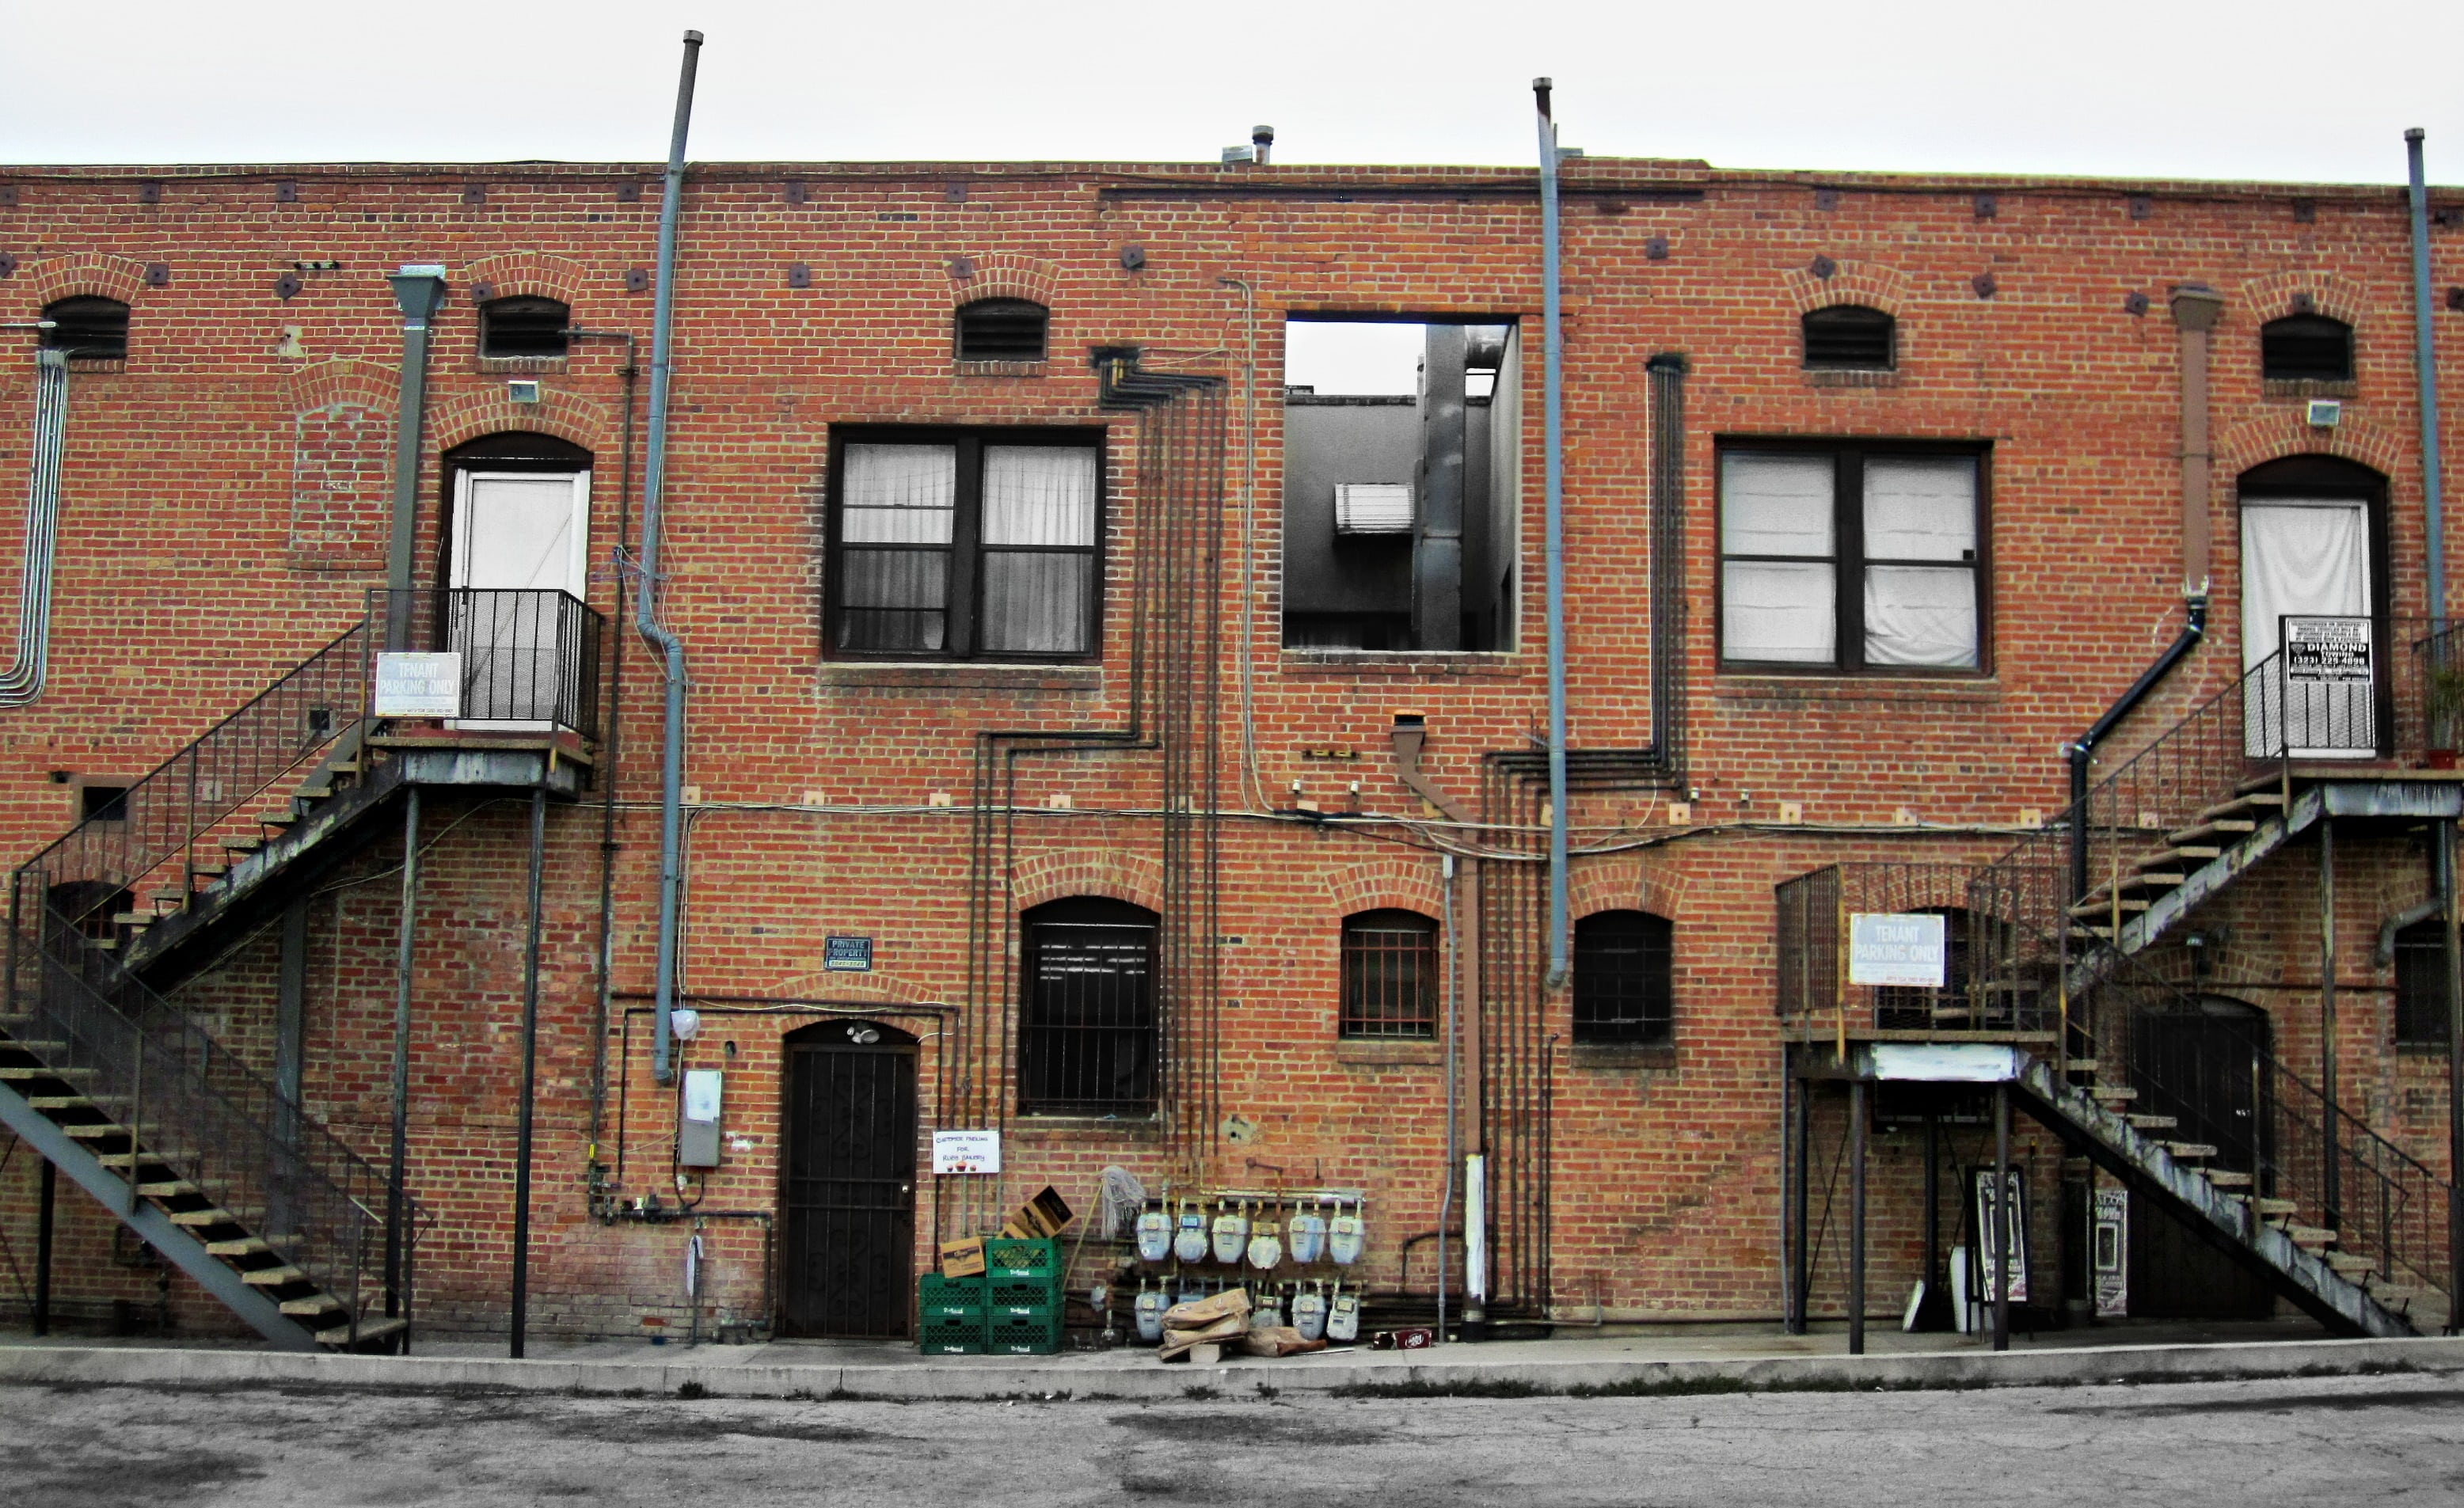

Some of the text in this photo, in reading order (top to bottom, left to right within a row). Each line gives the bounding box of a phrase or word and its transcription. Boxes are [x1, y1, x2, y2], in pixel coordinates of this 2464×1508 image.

[2307, 643, 2367, 652] DIAMOND
[398, 662, 439, 678] TENANT
[380, 678, 454, 695] PARKING ONLY
[1875, 925, 1920, 942] TENANT
[1854, 944, 1939, 962] PARKING ONLY
